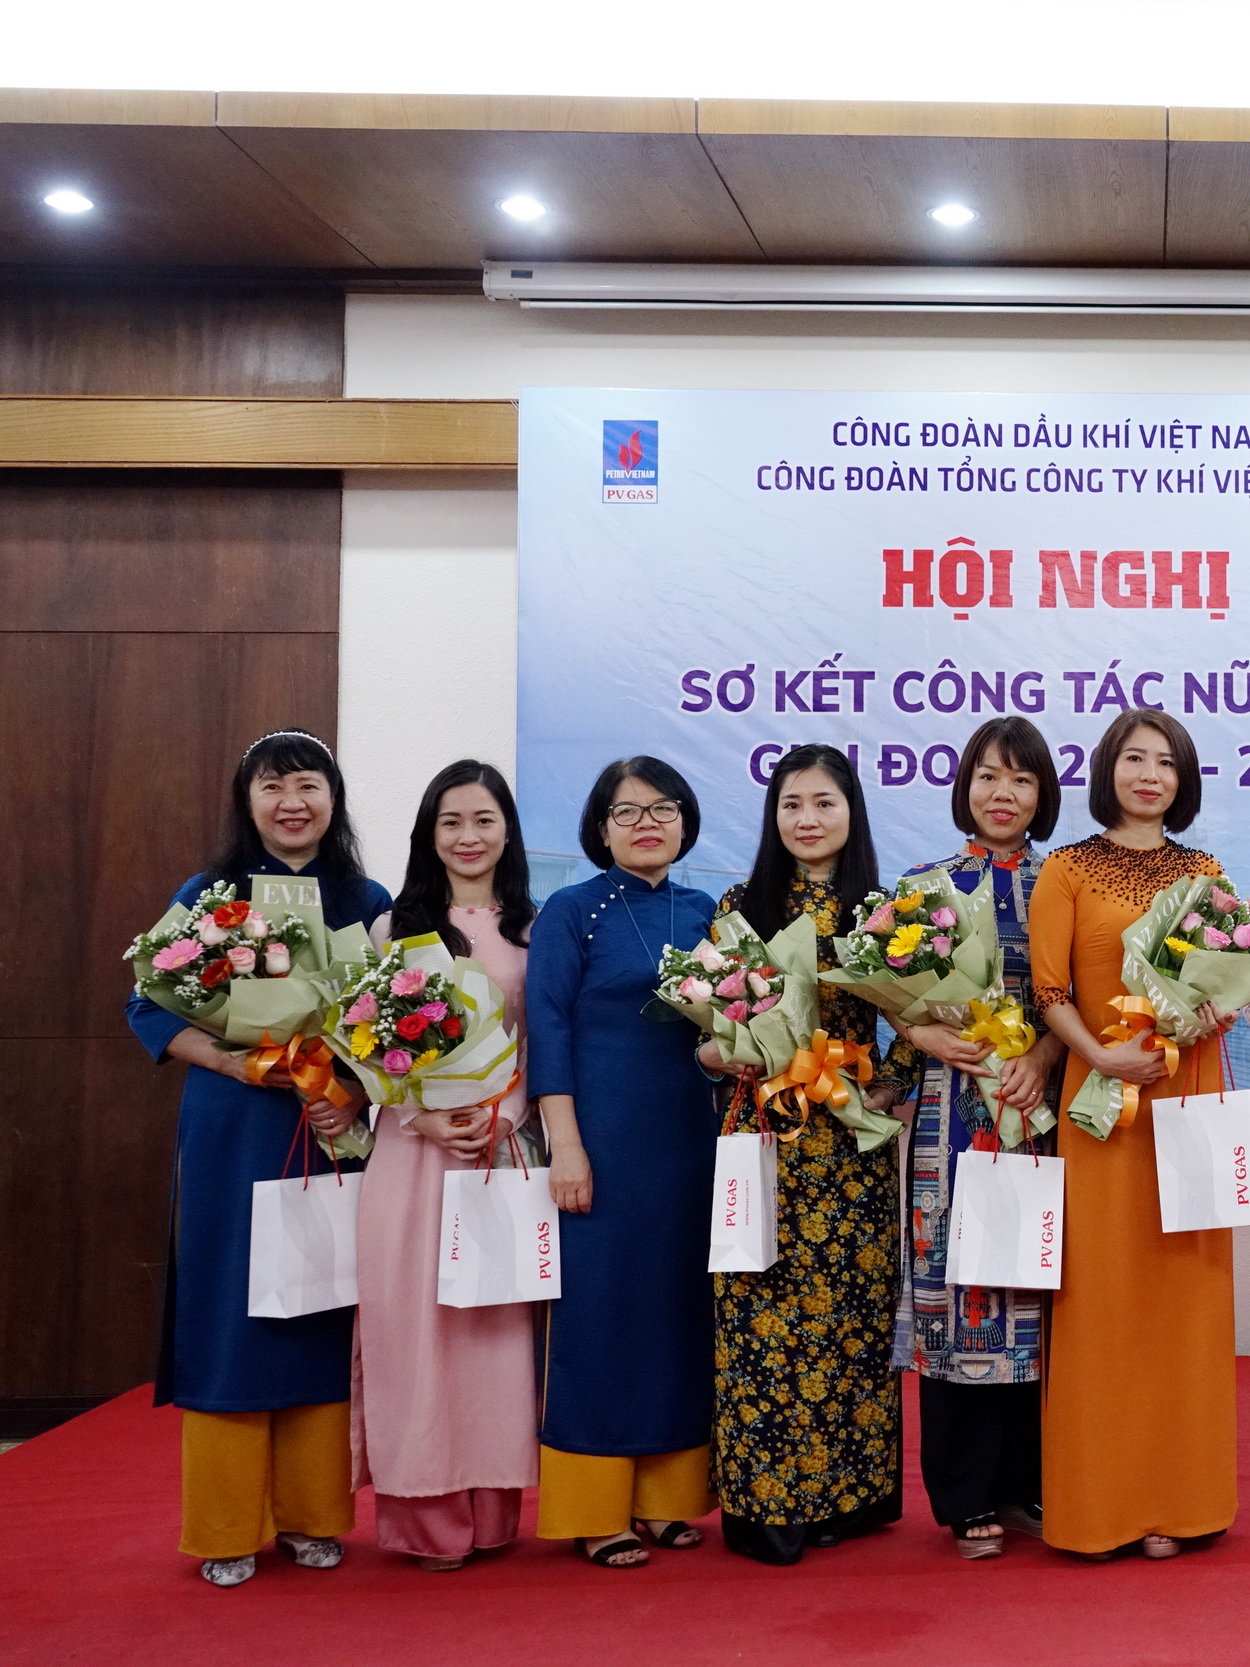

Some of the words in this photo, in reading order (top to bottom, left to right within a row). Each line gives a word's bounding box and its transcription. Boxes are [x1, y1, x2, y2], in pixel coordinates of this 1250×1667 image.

[833, 416, 911, 447] CÔNG
[920, 417, 1003, 448] ĐOÀN
[1013, 413, 1072, 448] DẦU
[1083, 418, 1131, 449] KHÍ
[1139, 419, 1203, 454] VIỆT
[605, 469, 656, 479] PETROVIETNAM
[757, 460, 835, 491] CÔNG
[845, 461, 928, 492] ĐOÀN
[938, 455, 1017, 492] TỔNG
[1026, 462, 1103, 493] CÔNG
[1112, 469, 1148, 493] TY
[1157, 463, 1206, 494] KHÍ
[607, 490, 625, 500] PV
[626, 490, 654, 500] GAS
[882, 536, 1013, 621] HỘI
[1039, 550, 1231, 621] NGHỊ
[680, 663, 756, 714] SƠ
[775, 652, 876, 713] KẾT
[893, 658, 1046, 714] CÔNG
[1063, 659, 1165, 714] TÁC
[1233, 1145, 1247, 1180] GAS
[726, 1178, 738, 1206] GAS
[1237, 1183, 1250, 1205] PV
[726, 1208, 736, 1227] PV
[1041, 1210, 1055, 1244] GAS
[537, 1221, 551, 1255] GAS
[539, 1258, 551, 1280] PV
[1040, 1246, 1053, 1268] PV
